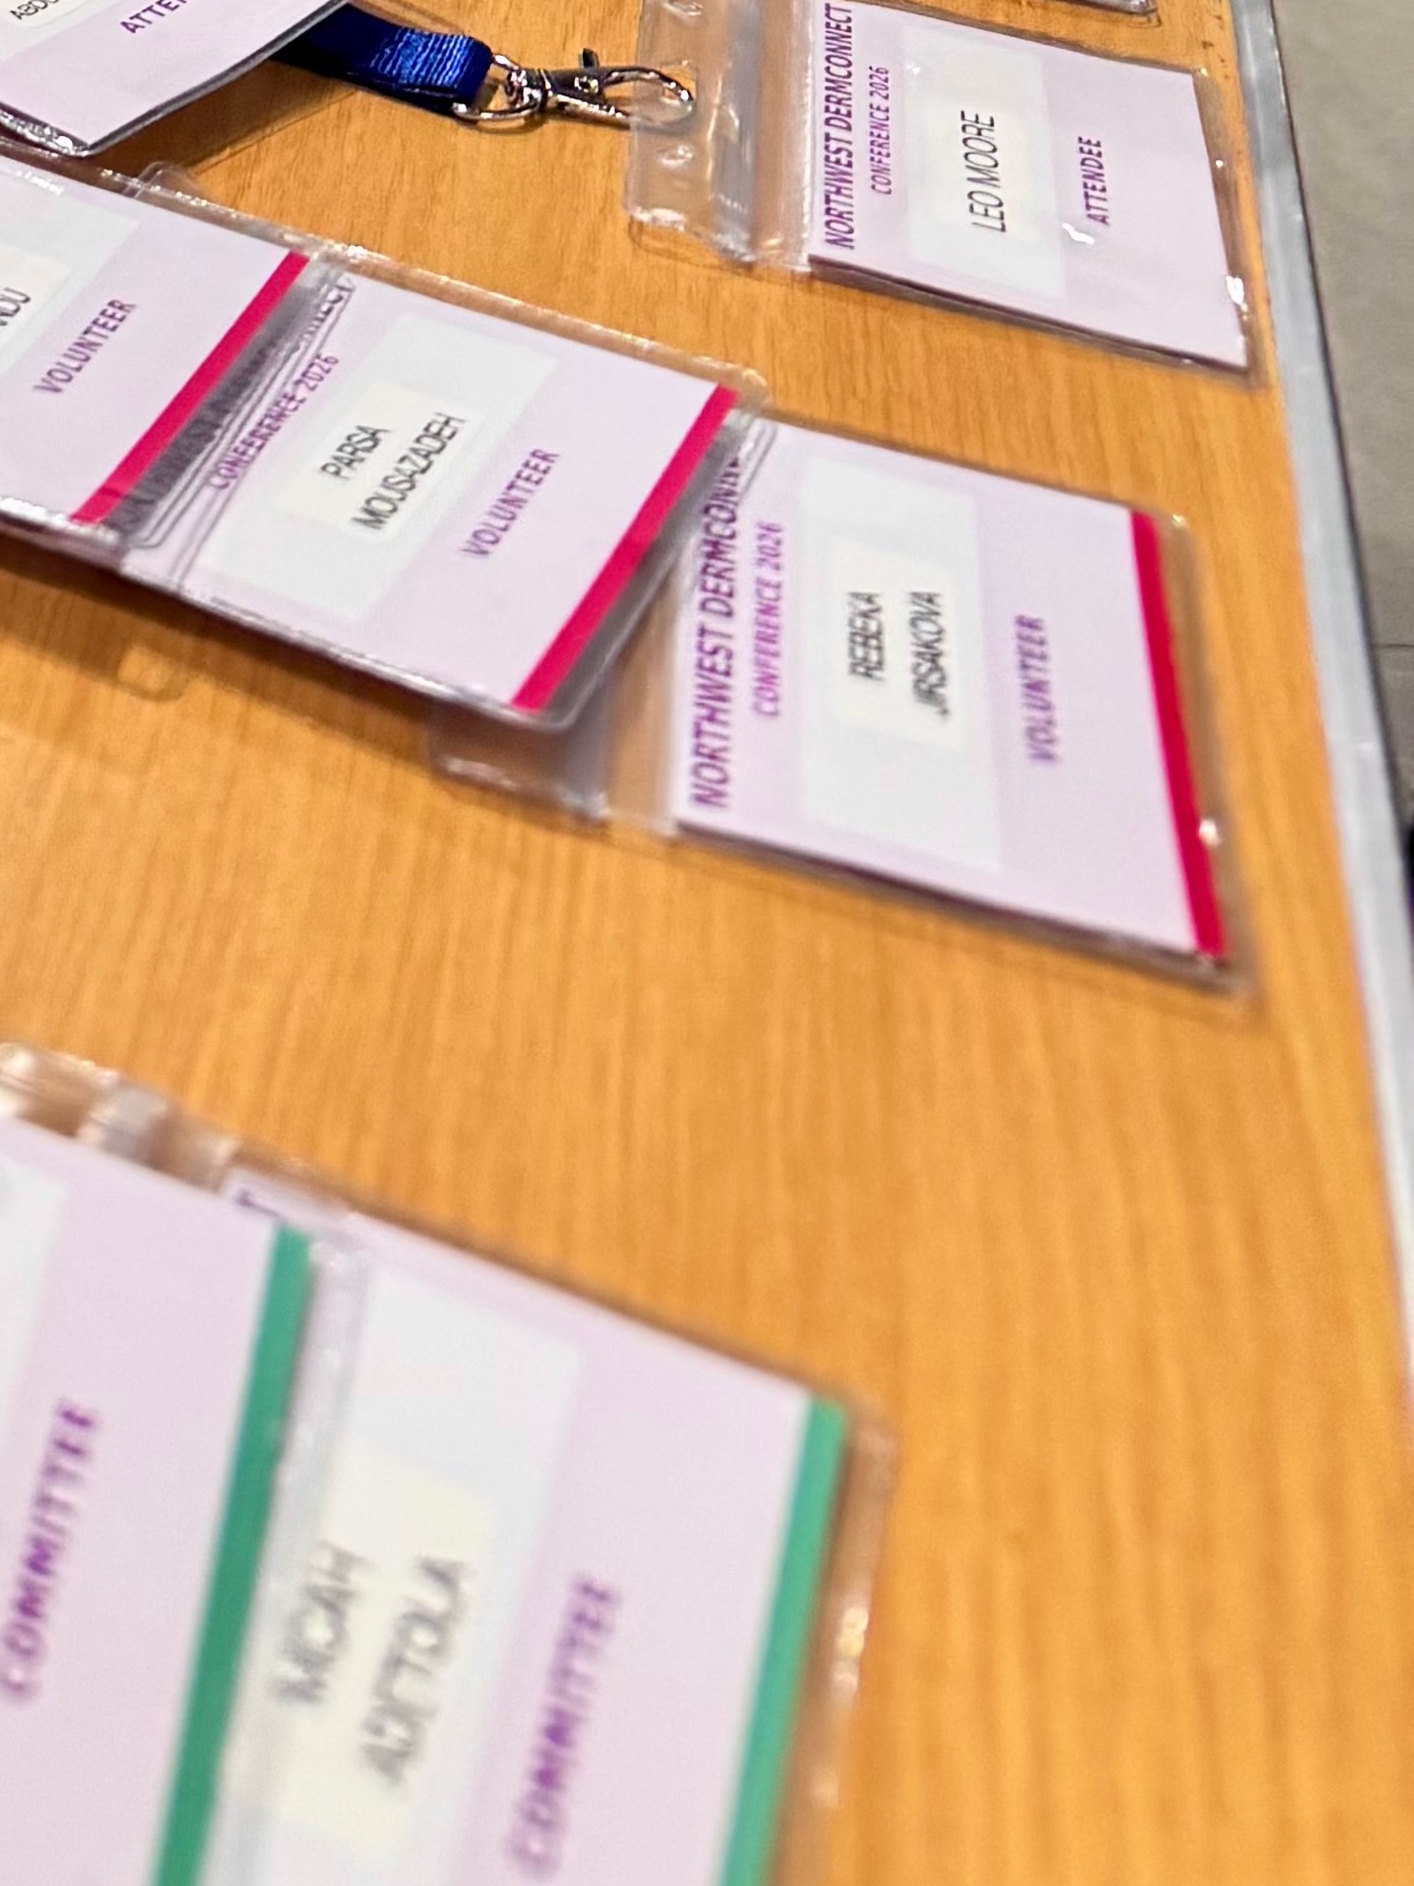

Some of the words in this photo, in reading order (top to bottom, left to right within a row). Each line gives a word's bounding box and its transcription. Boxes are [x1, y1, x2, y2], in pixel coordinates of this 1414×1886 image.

[823, 3, 855, 134] DERMCONNECT
[871, 66, 890, 104] 2026
[825, 134, 856, 250] NORTHWEST
[869, 105, 892, 196] CONFERENCE
[961, 111, 1005, 188] MOORE
[1076, 135, 1109, 224] ATTENDEE
[971, 187, 1008, 233] LEO
[33, 298, 138, 397] VOLUNTEER
[206, 388, 307, 490] CONFERENCE
[298, 352, 340, 397] 2026
[320, 423, 391, 482] PARSA
[351, 412, 466, 533] MOUSAZADEH
[460, 448, 559, 560] VOLUNTEER
[754, 522, 785, 571] 2026
[749, 575, 784, 718] CONFERENCE
[846, 591, 884, 683] REBEKA
[1015, 614, 1058, 765] VOLUNTEER
[689, 633, 737, 809] NORTHWEST
[512, 1577, 619, 1879] COMMITTEE
